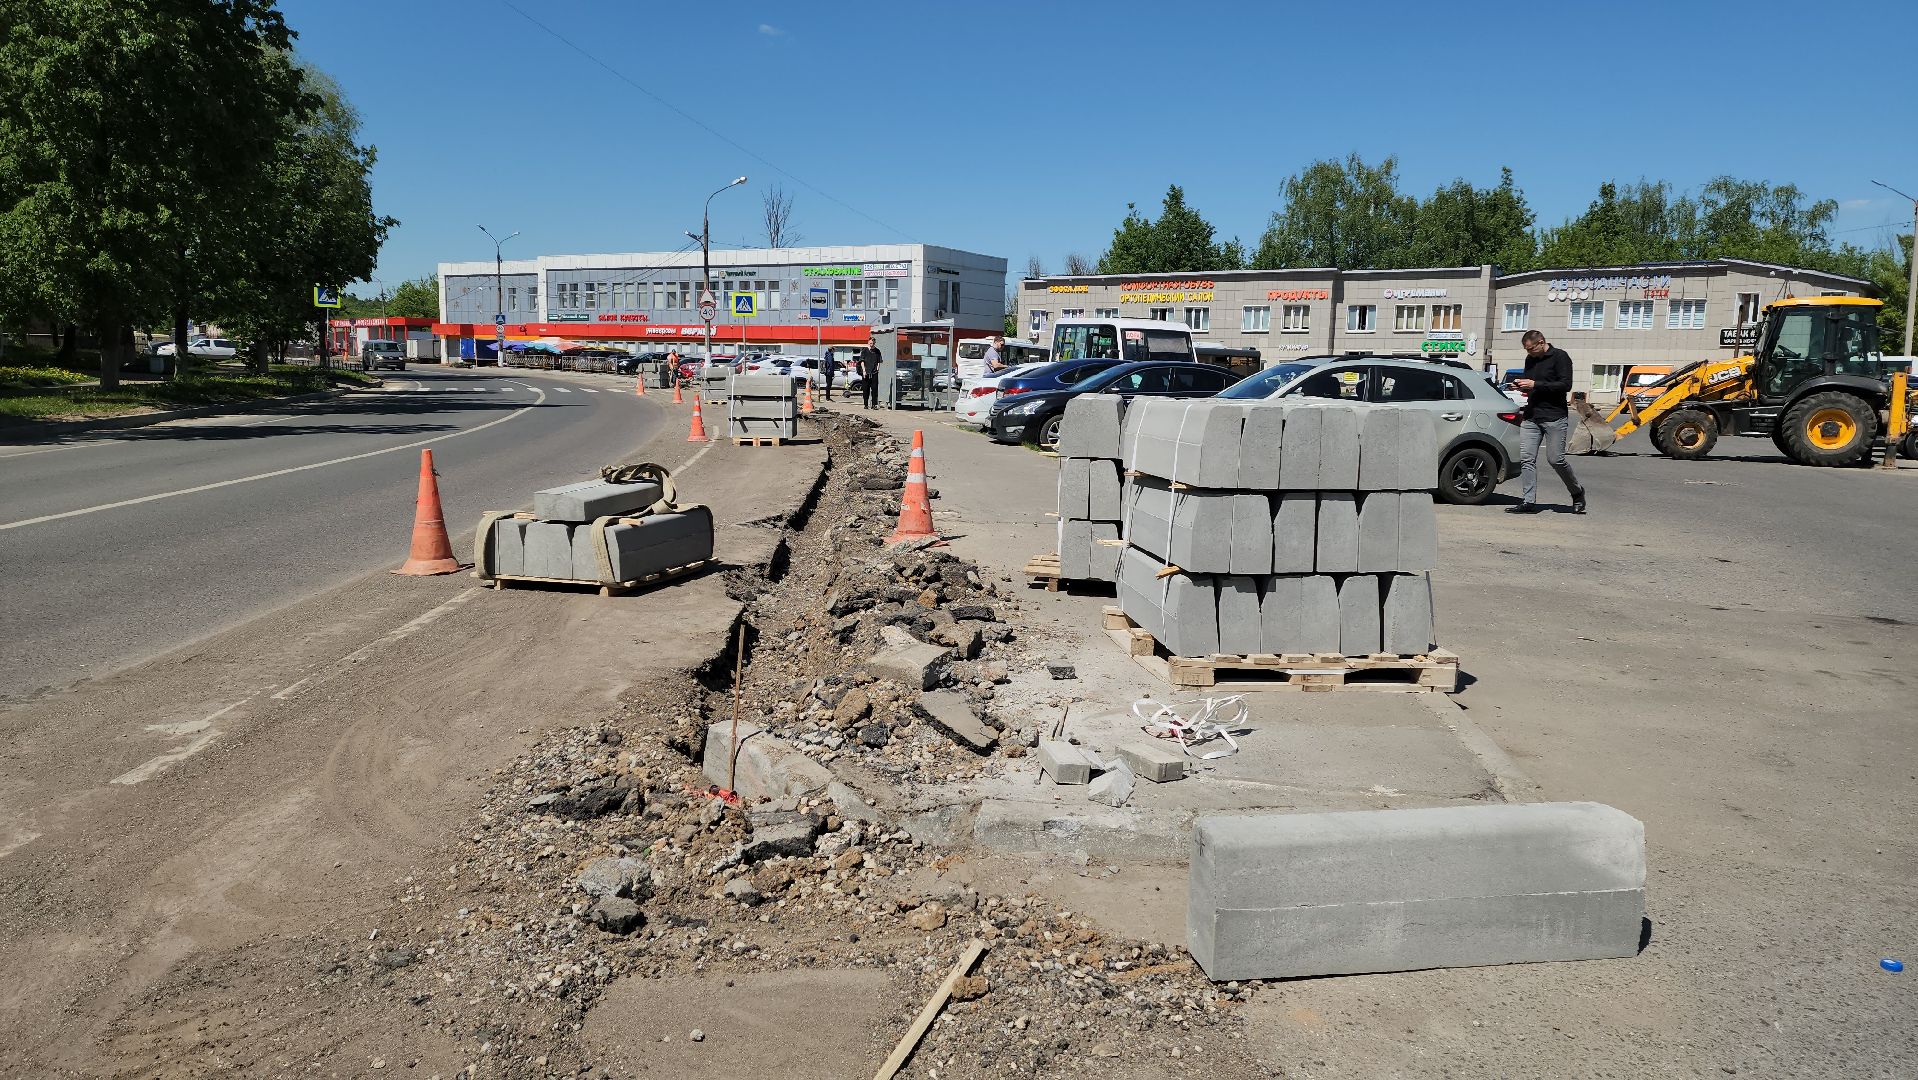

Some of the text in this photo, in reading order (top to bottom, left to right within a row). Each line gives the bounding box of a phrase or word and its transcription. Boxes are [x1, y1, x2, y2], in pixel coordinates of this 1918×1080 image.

[804, 267, 862, 277] СТРАХОВАНИЕ
[1185, 279, 1215, 290] ОБУВЬ
[1549, 274, 1671, 291] АВТОЗАПЧАСТИ
[1120, 291, 1214, 304] ОРТОПЕДИЧЕСКИЙ САЛОН
[1267, 289, 1329, 302] ПРОДУКТЫ
[702, 309, 713, 317] 40
[1420, 340, 1467, 353] СТИКС
[1708, 366, 1741, 384] JCB
